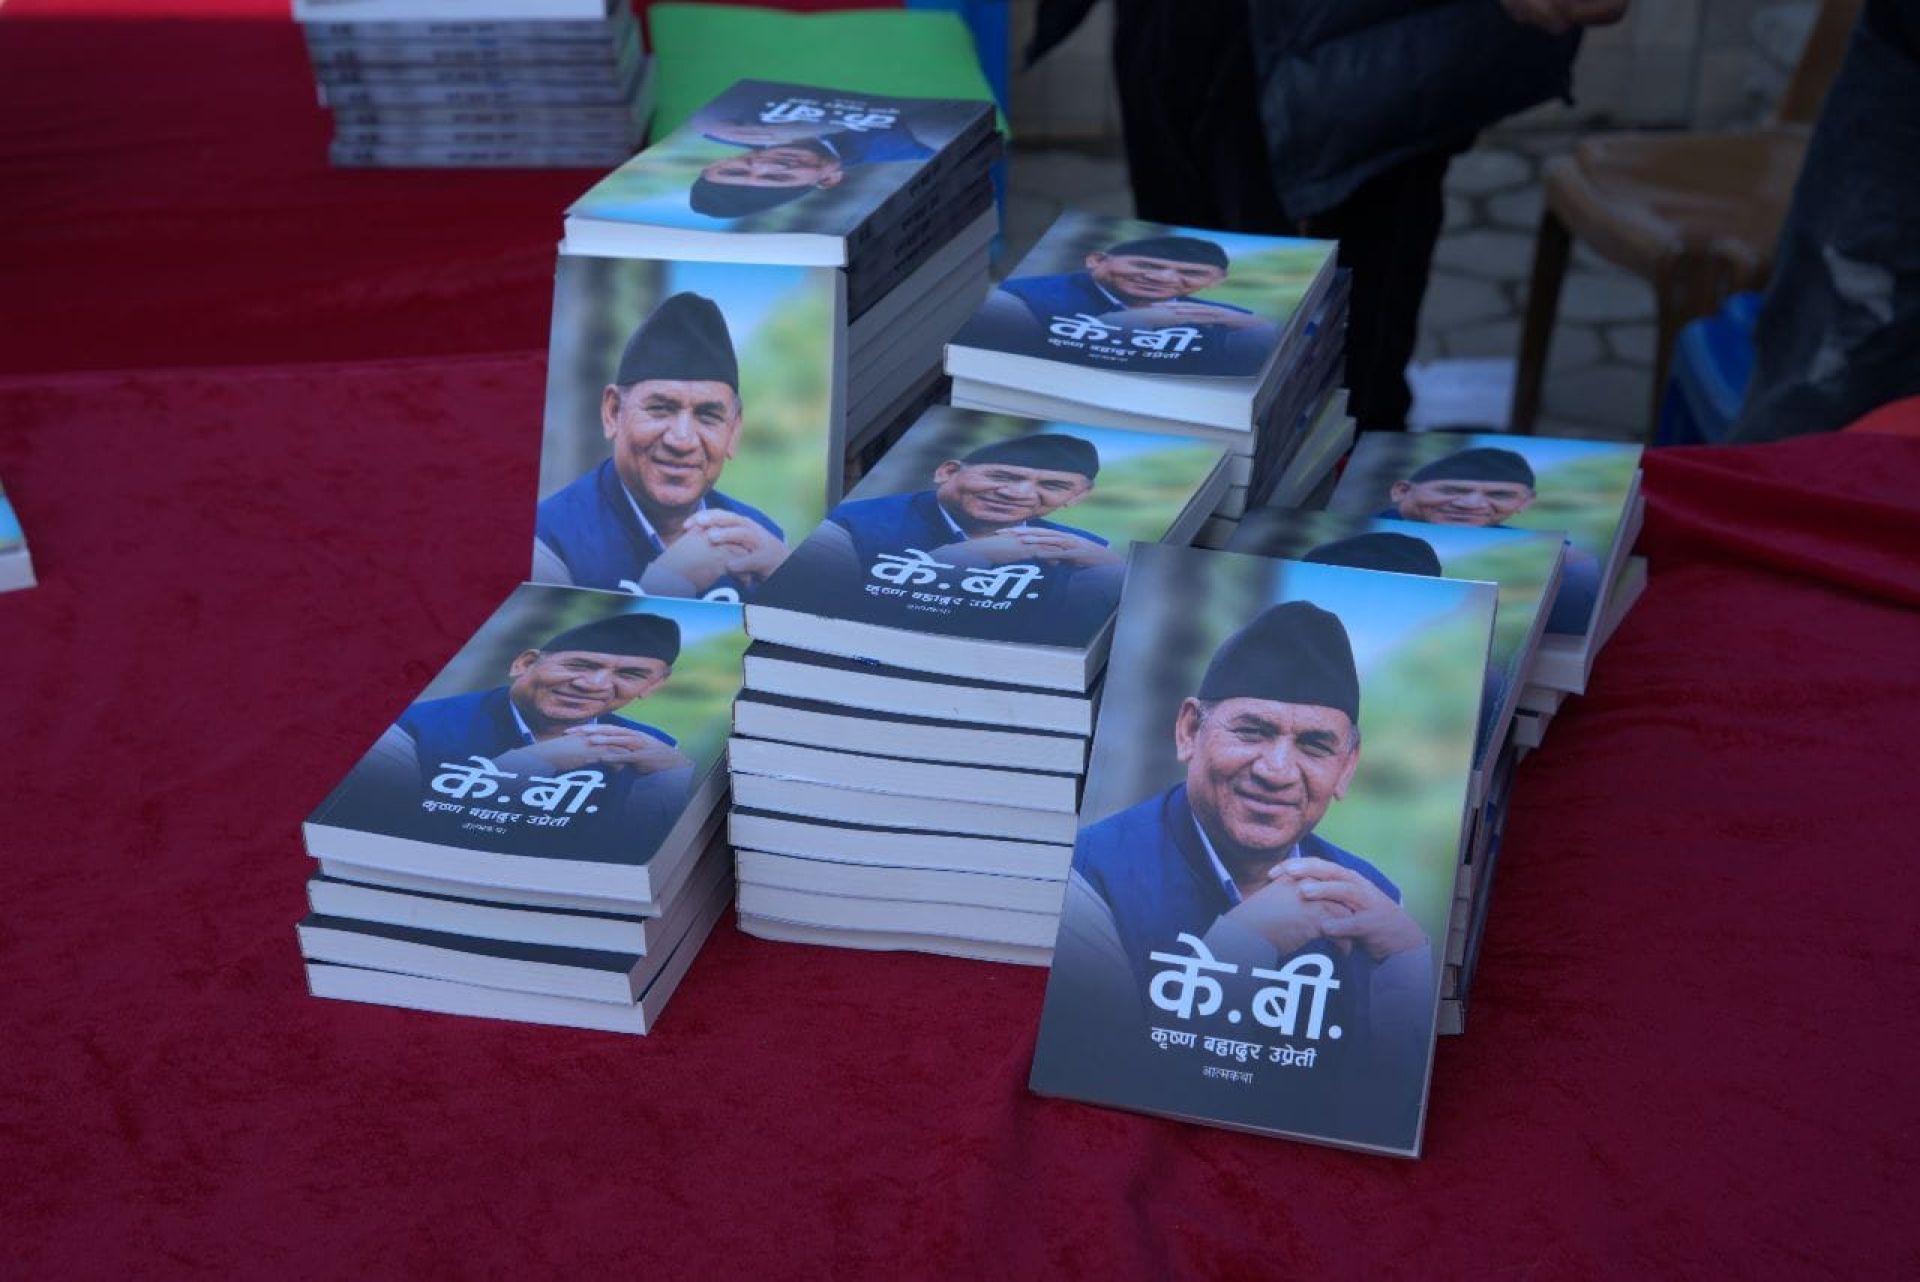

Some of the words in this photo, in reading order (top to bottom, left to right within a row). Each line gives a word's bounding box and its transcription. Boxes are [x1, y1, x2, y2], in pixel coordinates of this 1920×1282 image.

[431, 755, 607, 813] के.बी.
[1149, 932, 1342, 1040] के.बी.
[1151, 1027, 1197, 1049] कृष्ण
[1203, 1036, 1263, 1062] बहादुर
[1269, 1045, 1317, 1068] उप्रेती
